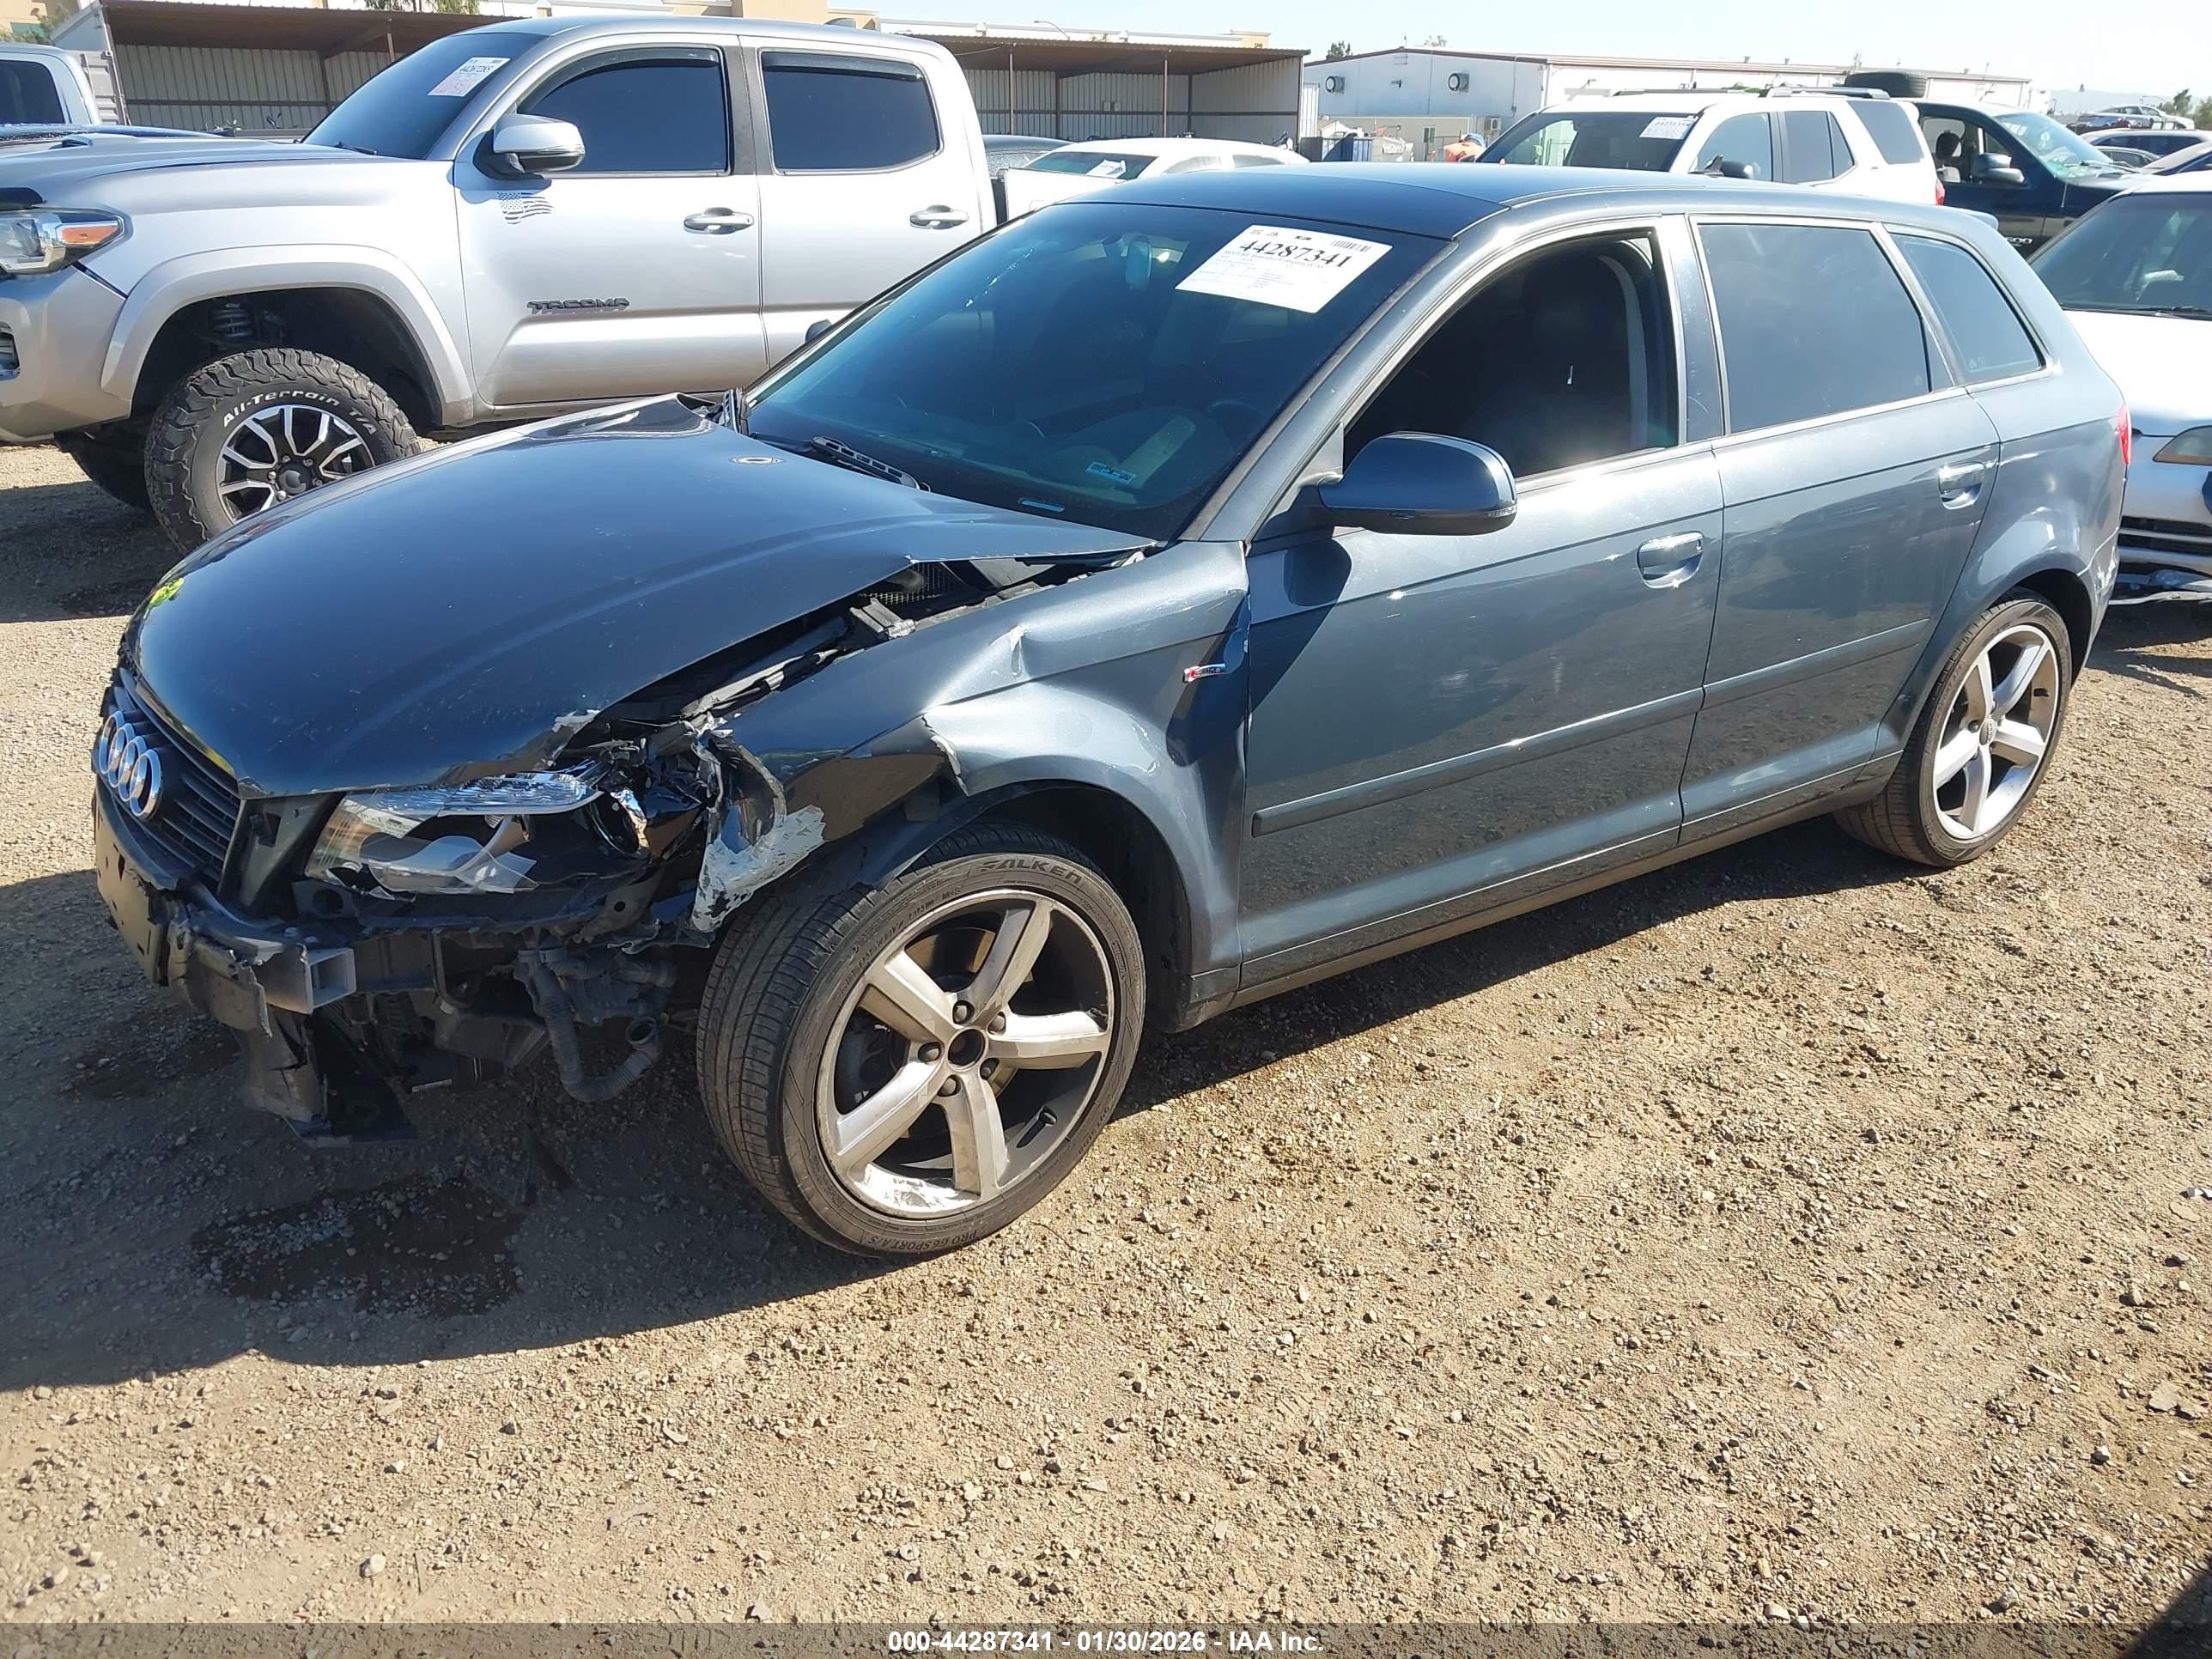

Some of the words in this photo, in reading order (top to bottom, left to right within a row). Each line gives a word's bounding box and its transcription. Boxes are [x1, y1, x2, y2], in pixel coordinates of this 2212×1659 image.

[1239, 240, 1352, 268] 44287341
[526, 297, 630, 314] TACOMA
[222, 390, 340, 428] All-Terrain
[349, 407, 377, 435] T/A
[979, 858, 1082, 885] FALKEN
[867, 1236, 891, 1249] A/S
[951, 1230, 977, 1244] PRO
